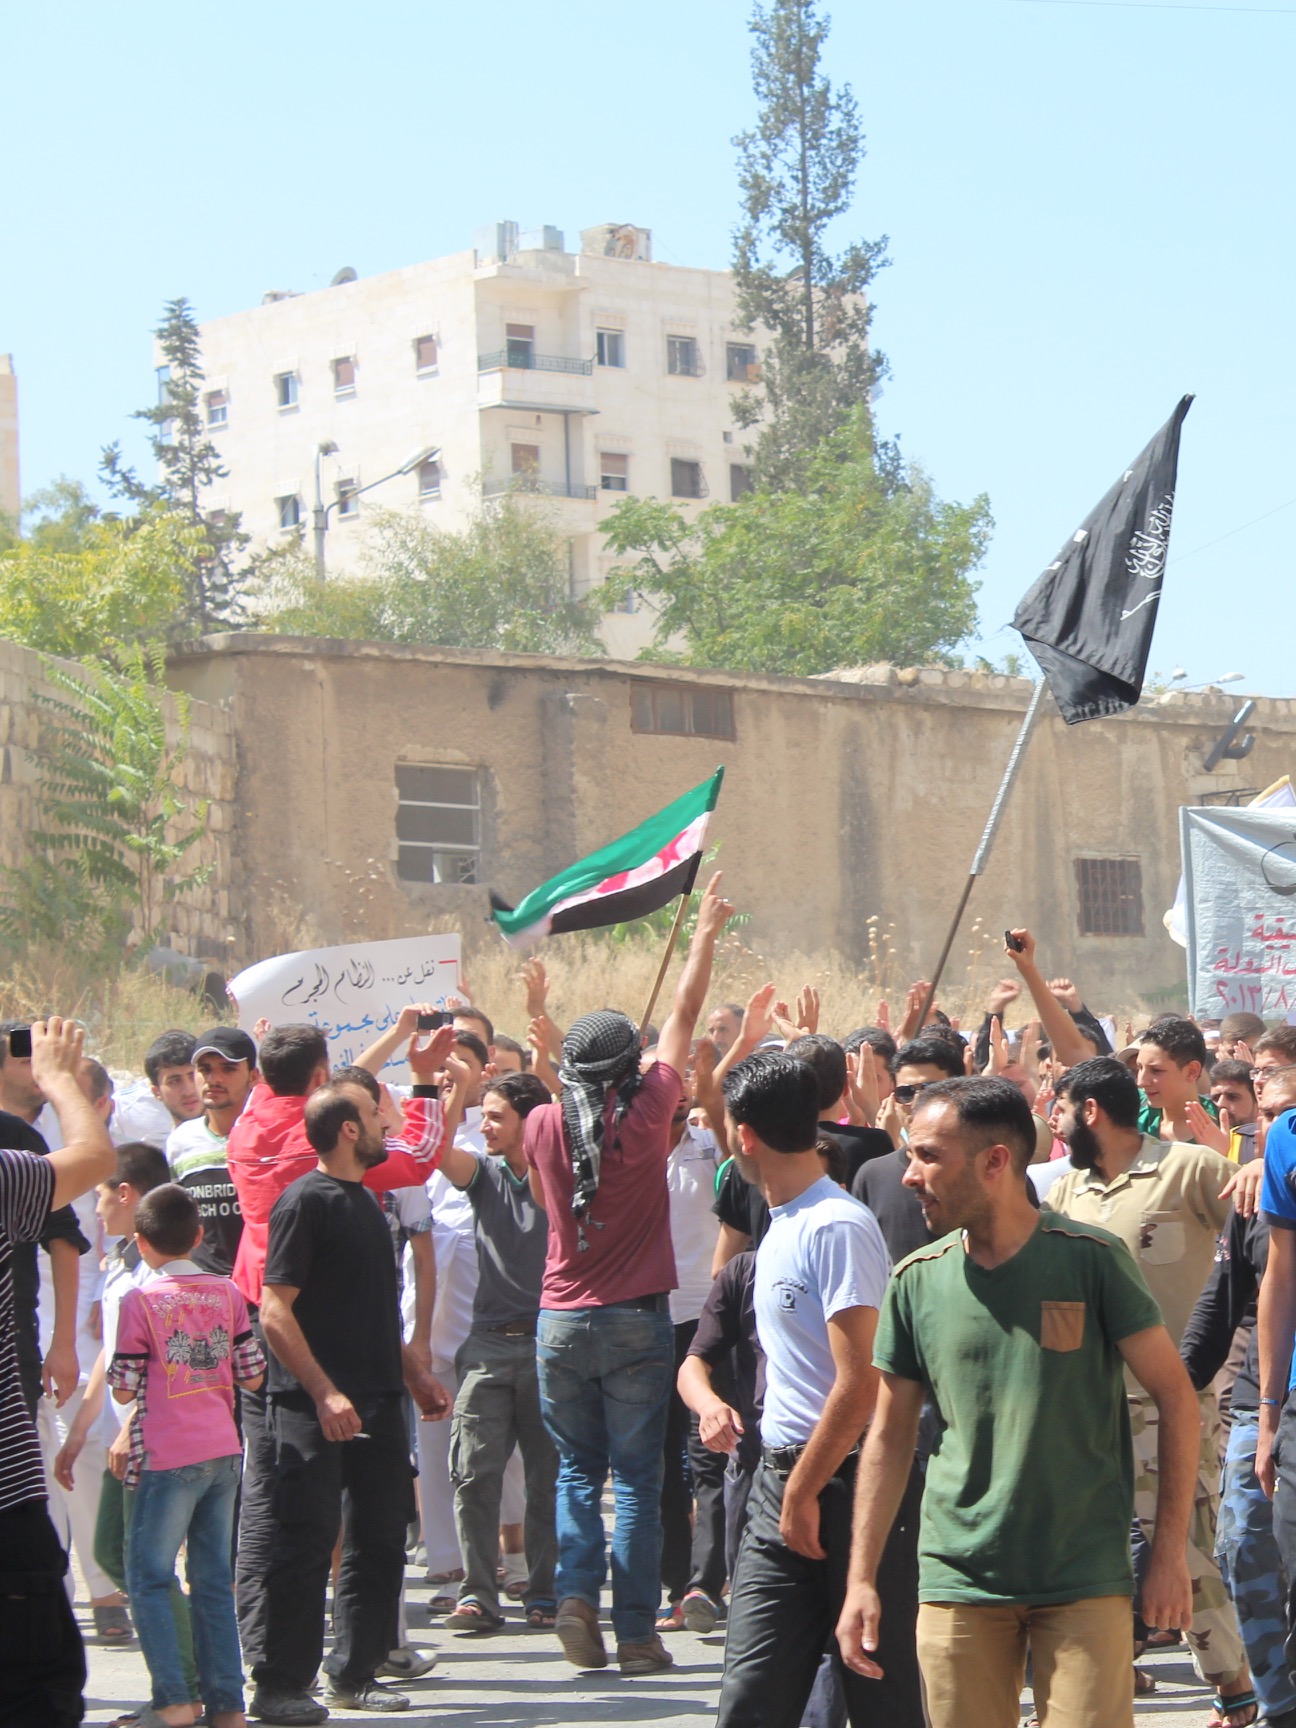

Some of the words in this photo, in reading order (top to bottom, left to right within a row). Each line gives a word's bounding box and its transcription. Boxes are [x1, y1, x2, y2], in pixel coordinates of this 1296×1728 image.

[414, 959, 435, 985] نقل
[186, 1183, 238, 1198] ONBRID
[198, 1201, 242, 1217] CHOO
